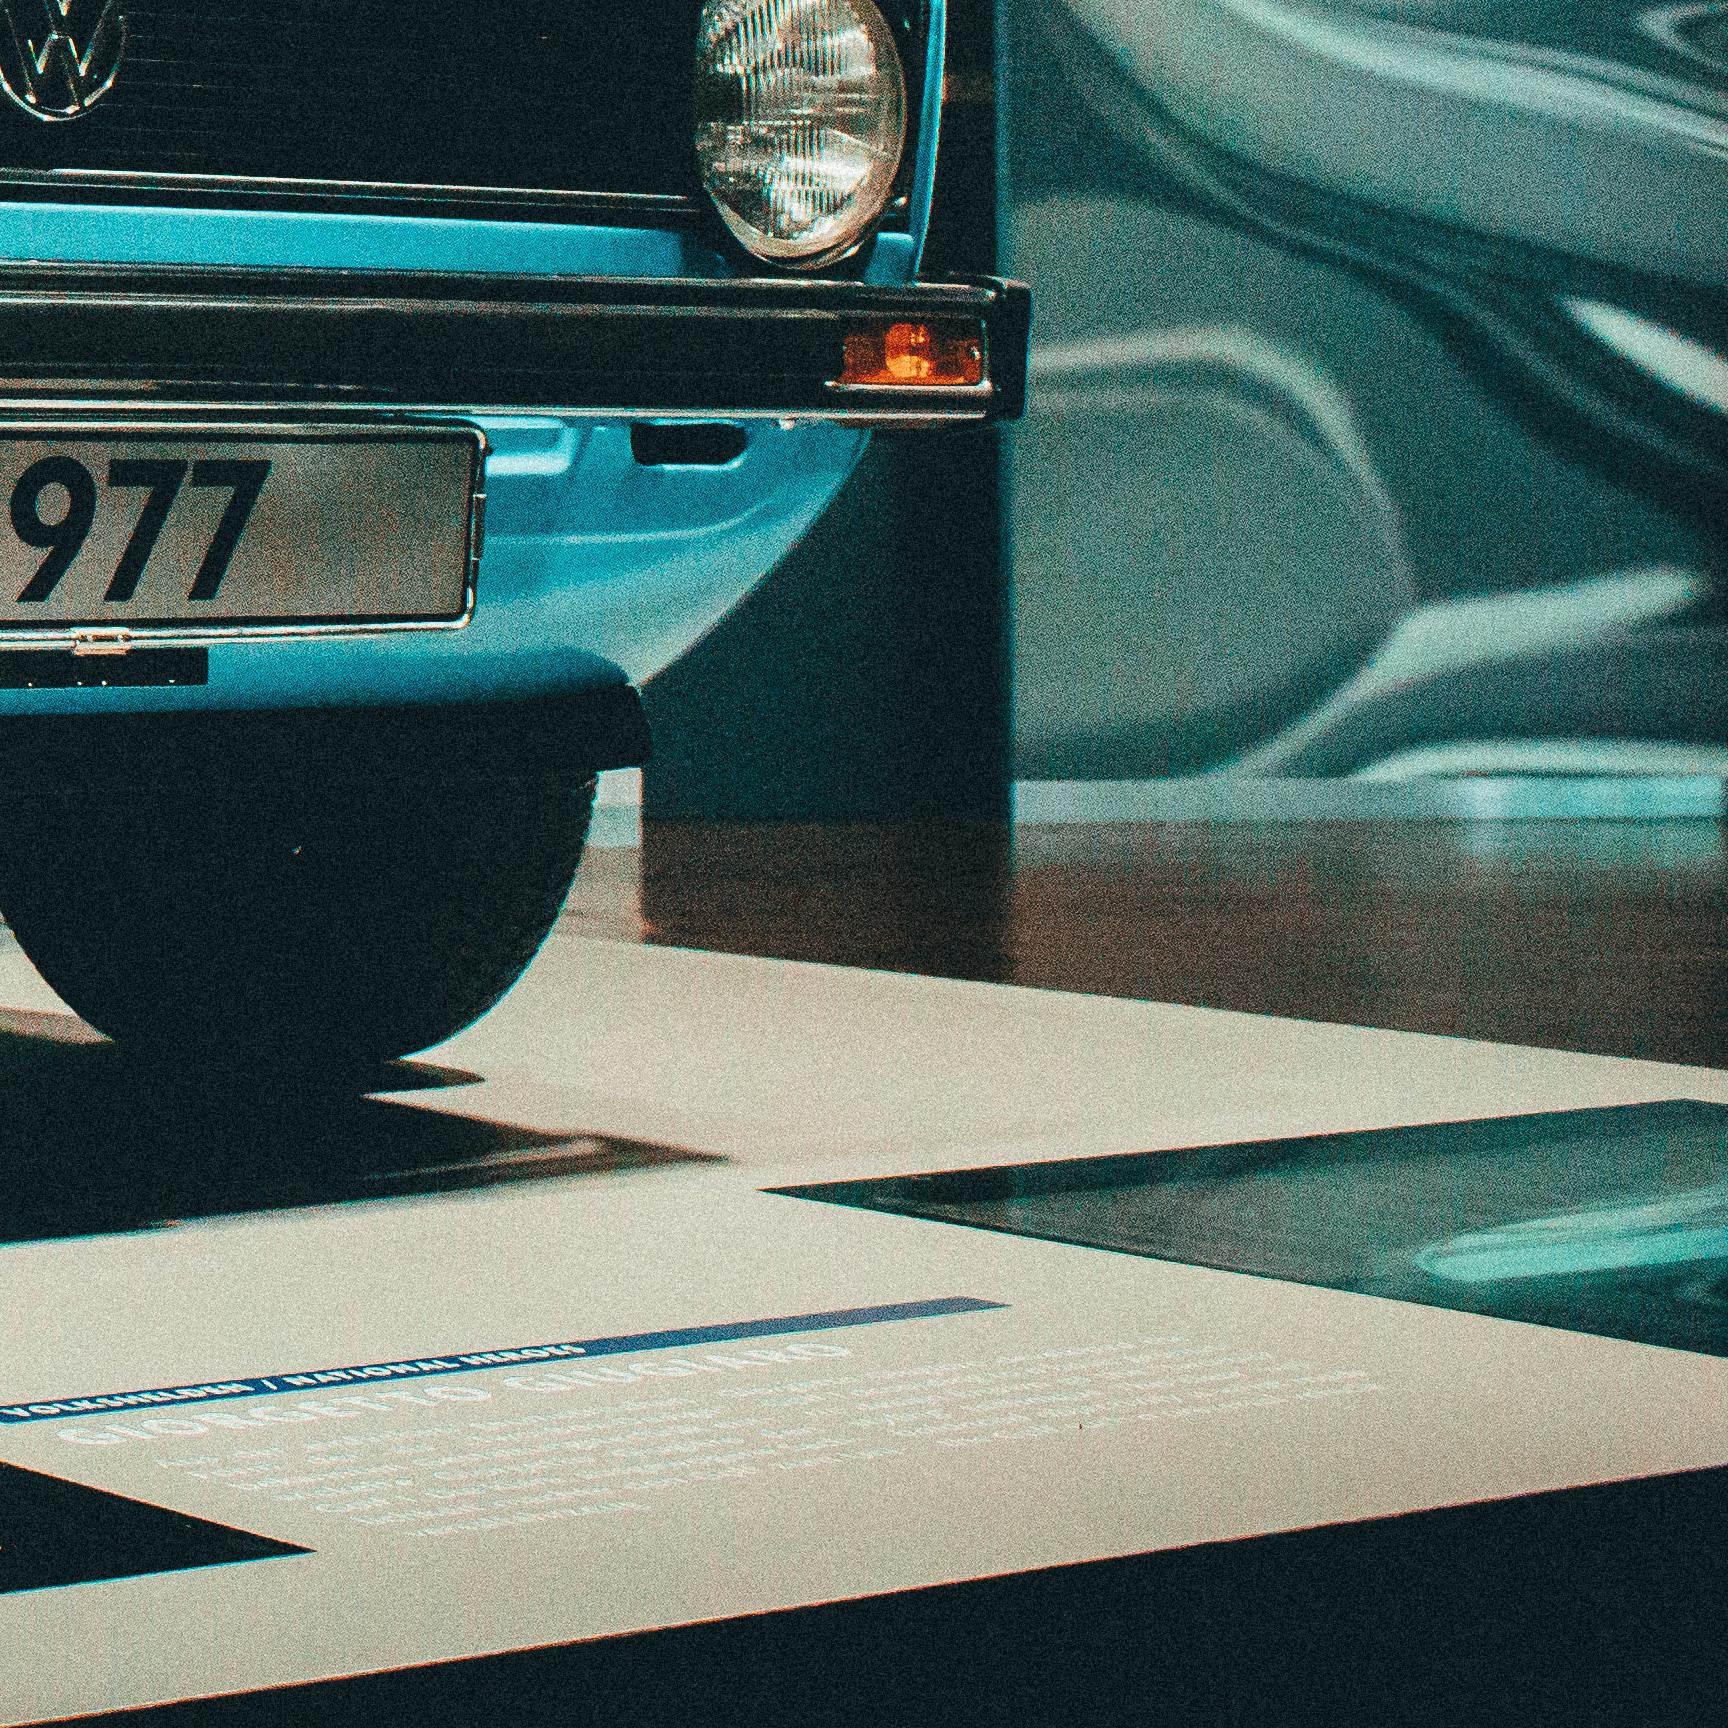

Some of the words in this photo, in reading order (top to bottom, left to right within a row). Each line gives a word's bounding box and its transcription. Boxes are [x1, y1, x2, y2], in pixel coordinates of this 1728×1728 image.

[0, 1382, 255, 1417] VOLKSHELDEN
[282, 1358, 460, 1387] NATIONAL
[458, 1344, 586, 1365] HEROES
[55, 1384, 492, 1445] GIORGETTO
[502, 1343, 848, 1391] GIUGIARO
